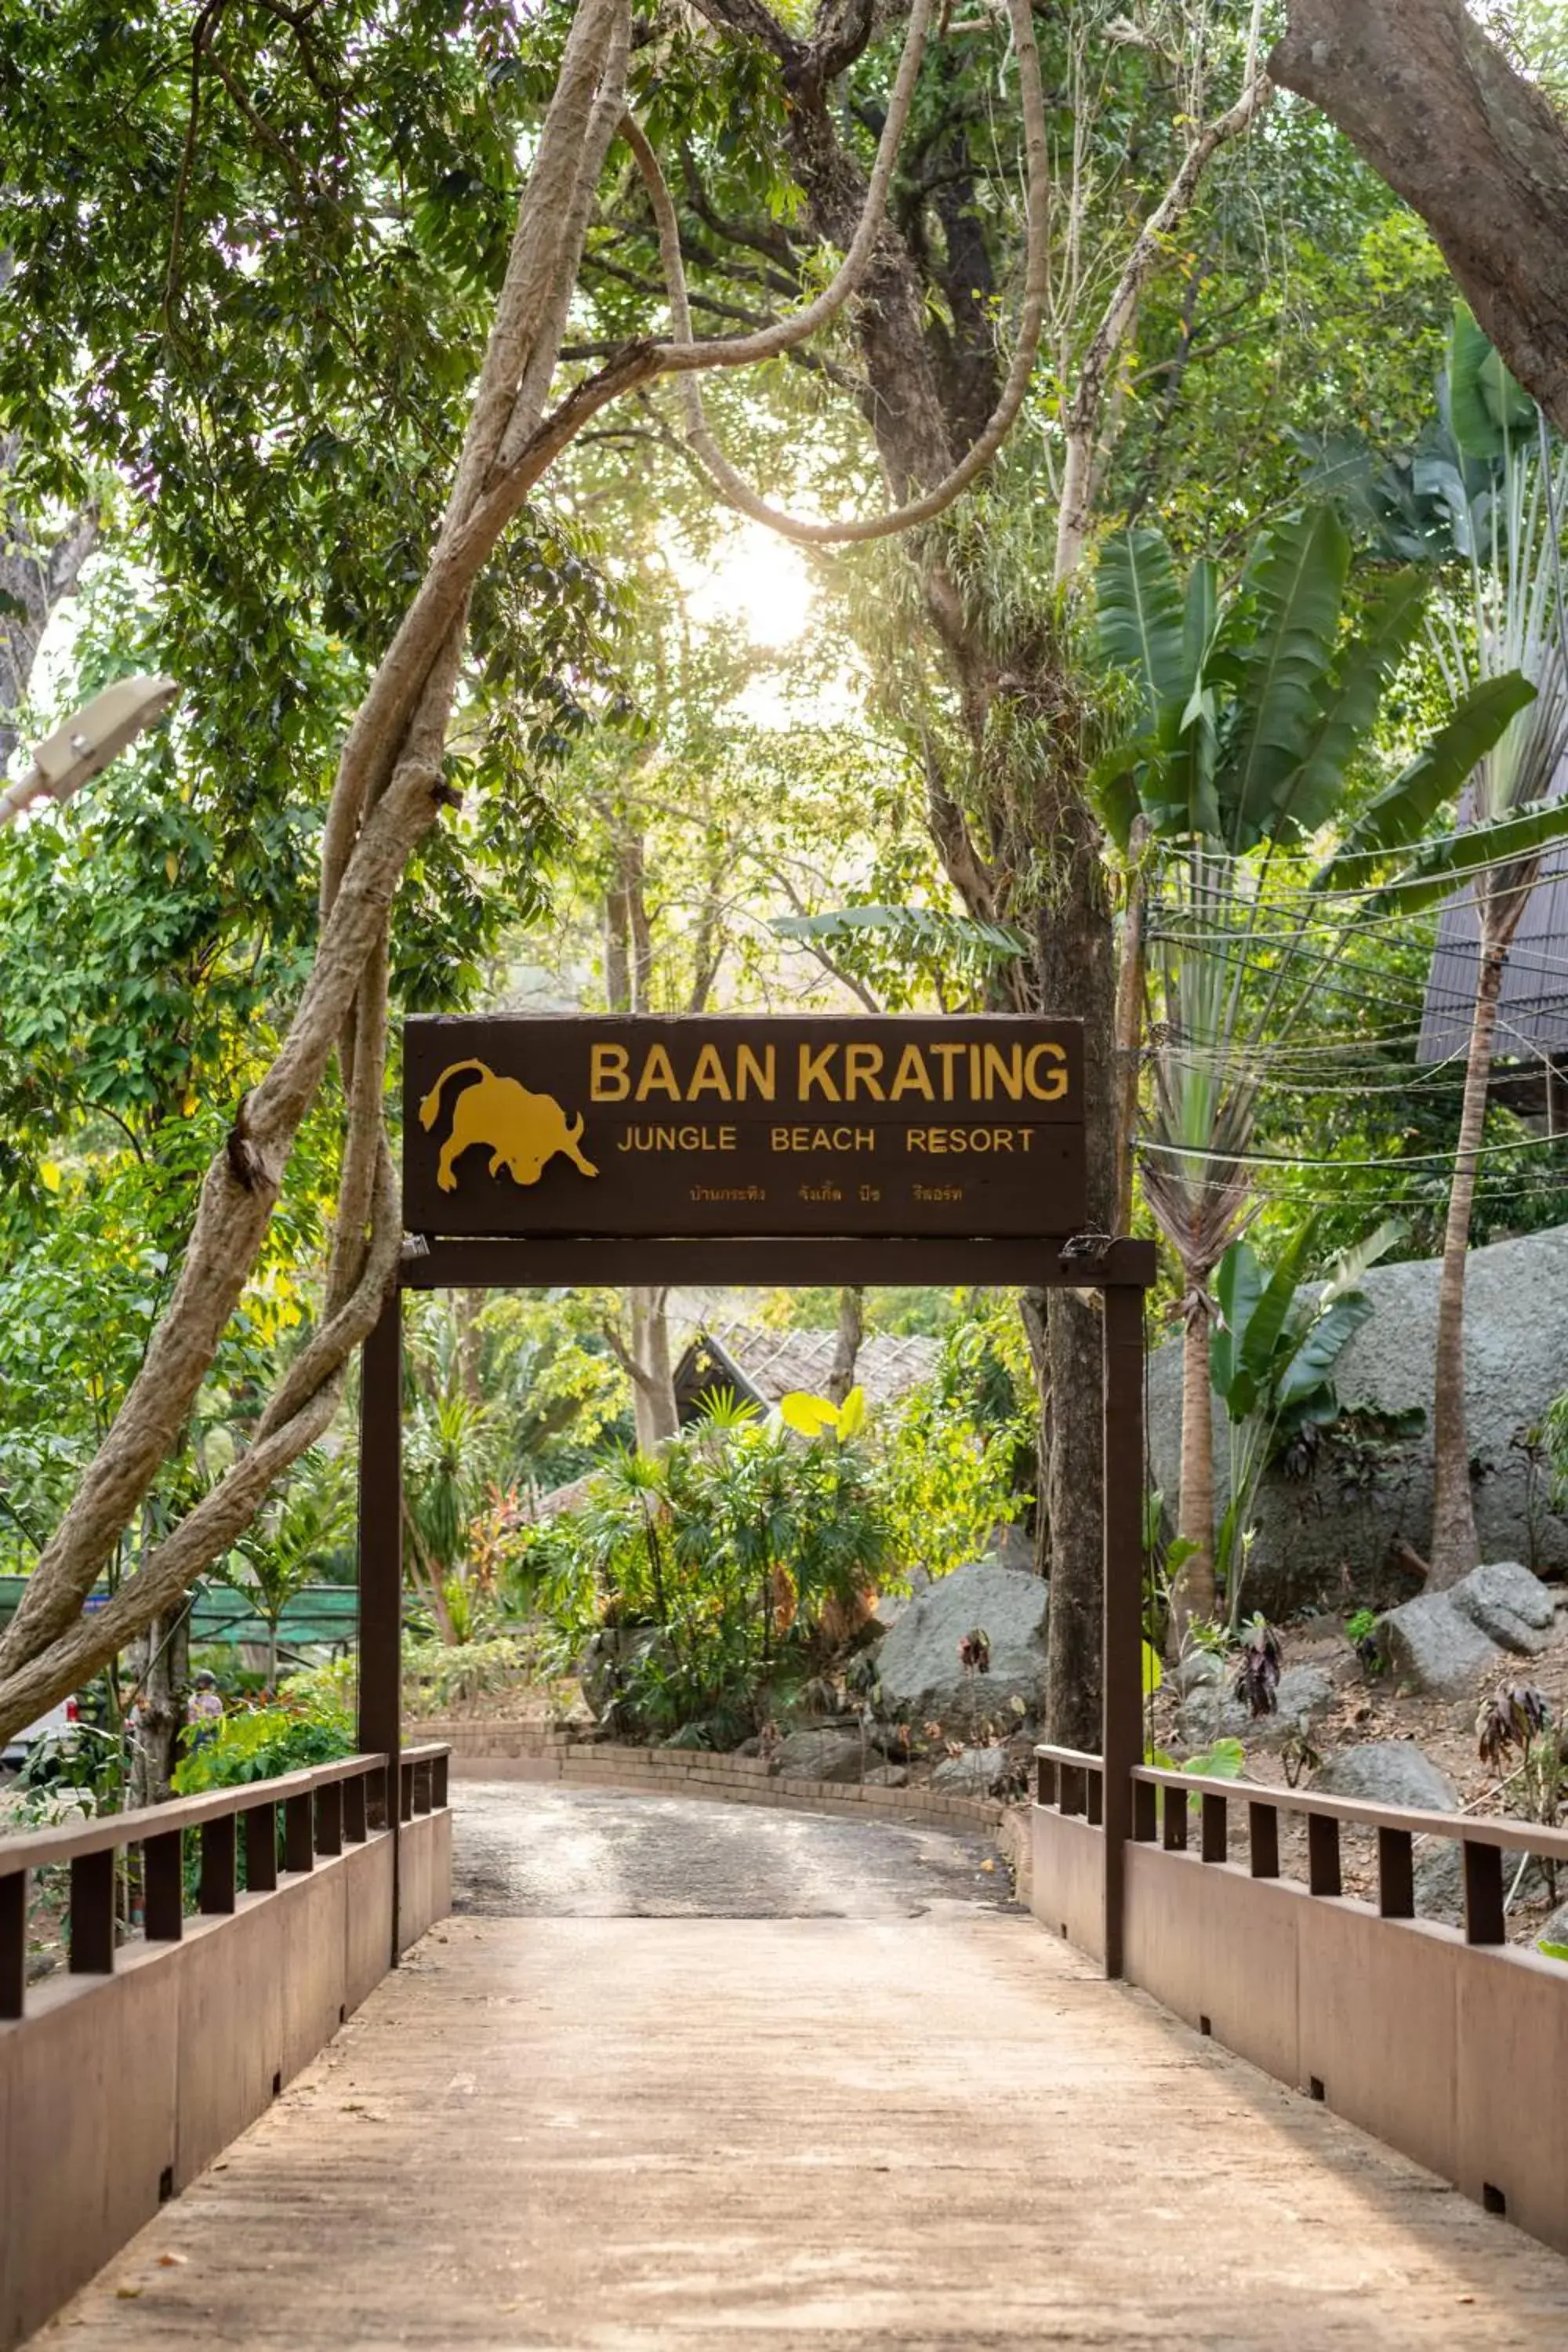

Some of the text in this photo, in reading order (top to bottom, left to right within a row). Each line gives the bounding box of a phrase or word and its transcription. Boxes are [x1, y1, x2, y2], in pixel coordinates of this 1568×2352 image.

[590, 1042, 1069, 1102] BAAN KRATING
[617, 1126, 1034, 1154] JUNGLE BEACH RESORT
[689, 1184, 767, 1201] บ้านกระทิง
